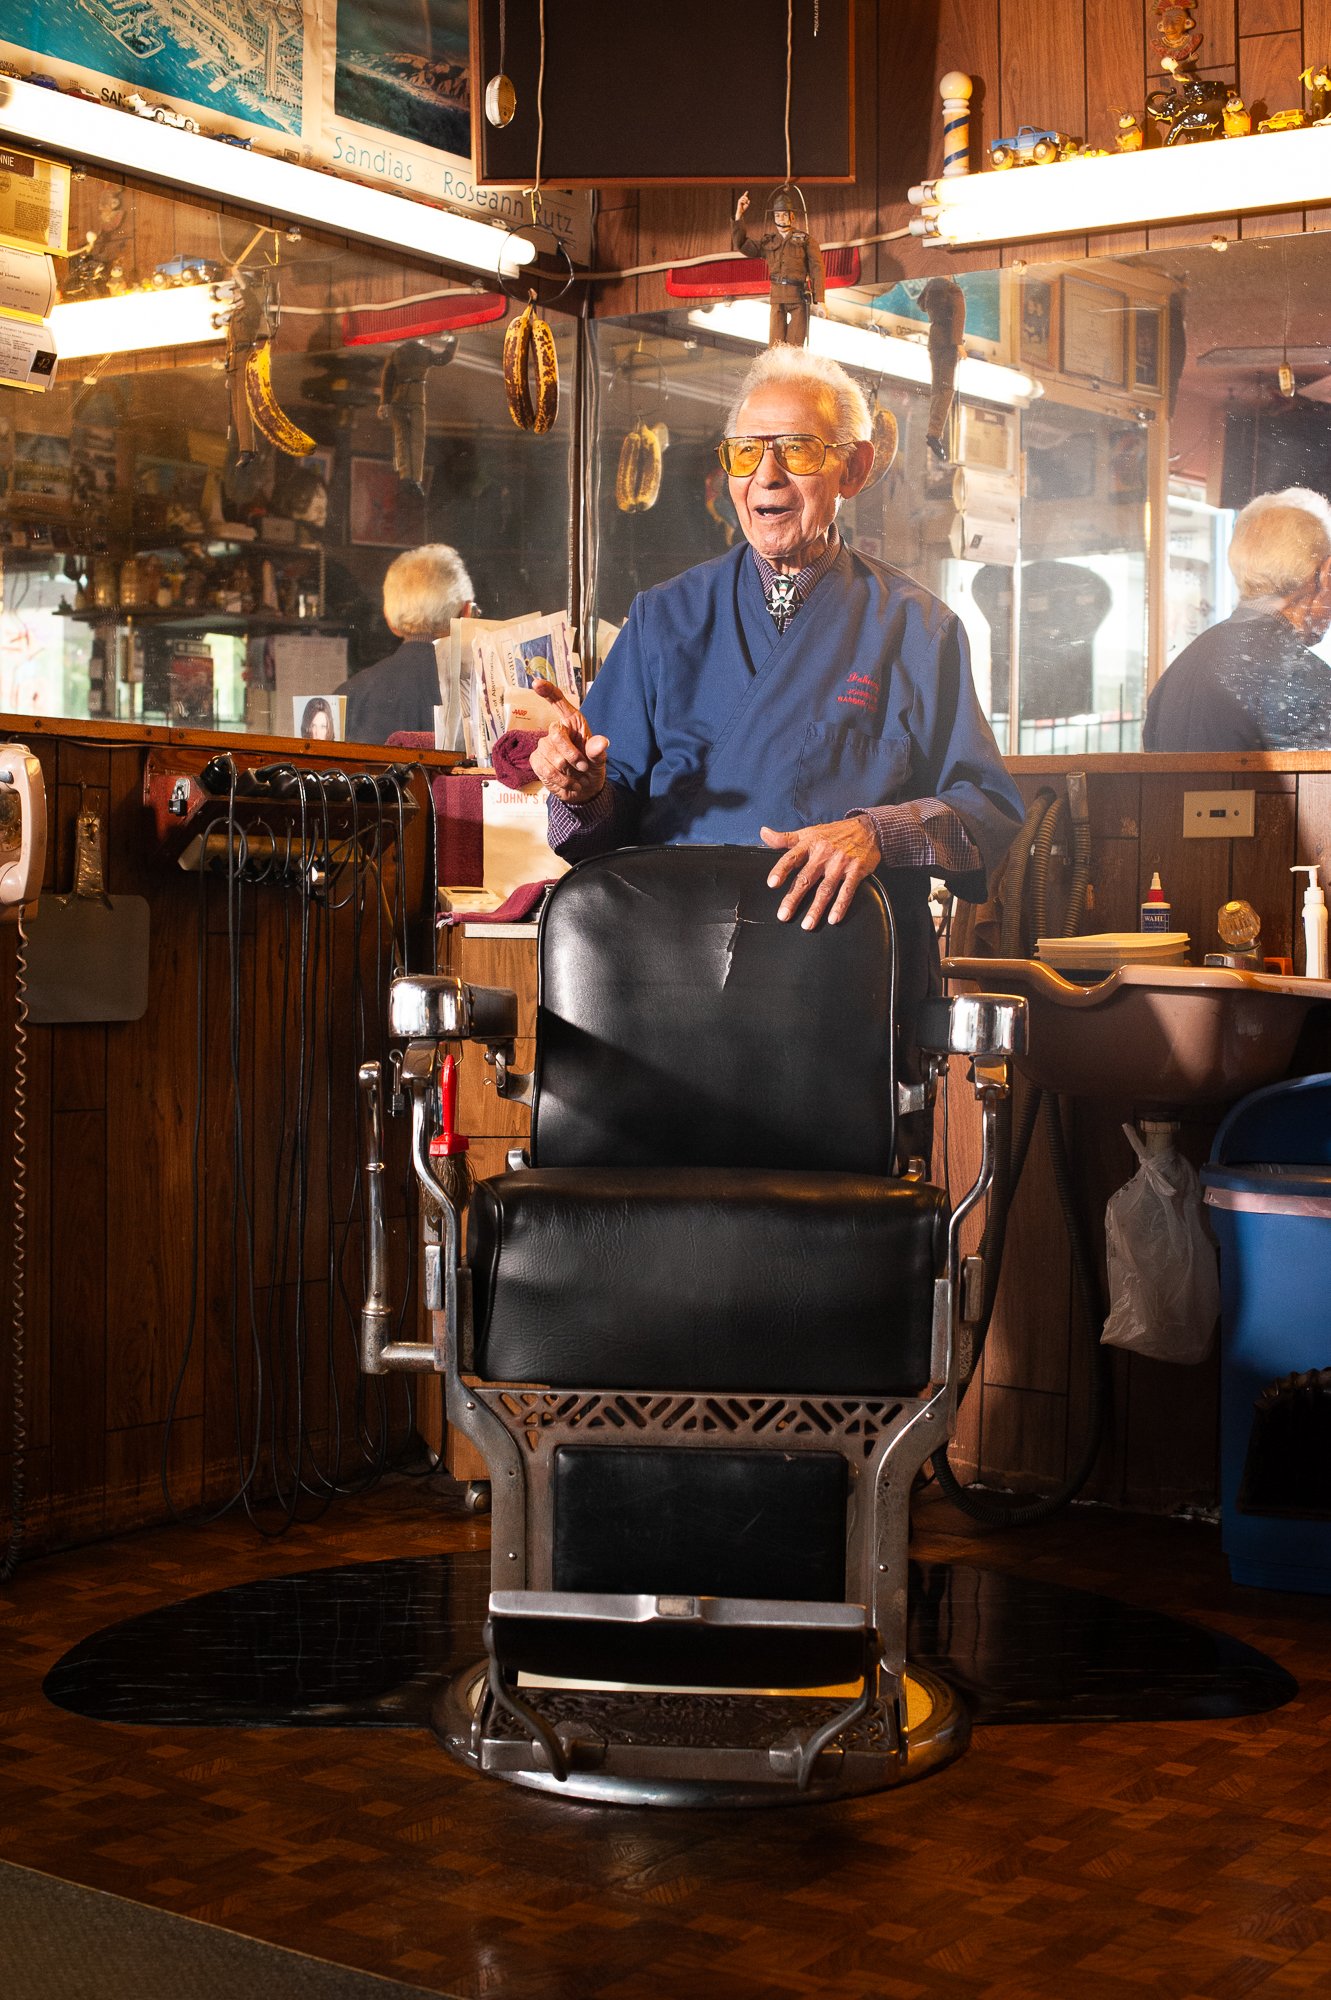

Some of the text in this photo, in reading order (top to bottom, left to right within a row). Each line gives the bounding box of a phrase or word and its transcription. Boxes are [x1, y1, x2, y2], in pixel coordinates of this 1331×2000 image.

[101, 87, 126, 107] SAN
[333, 136, 412, 182] Sandias
[443, 171, 573, 235] Roseann Rutz
[496, 792, 539, 805] JOHNY'S
